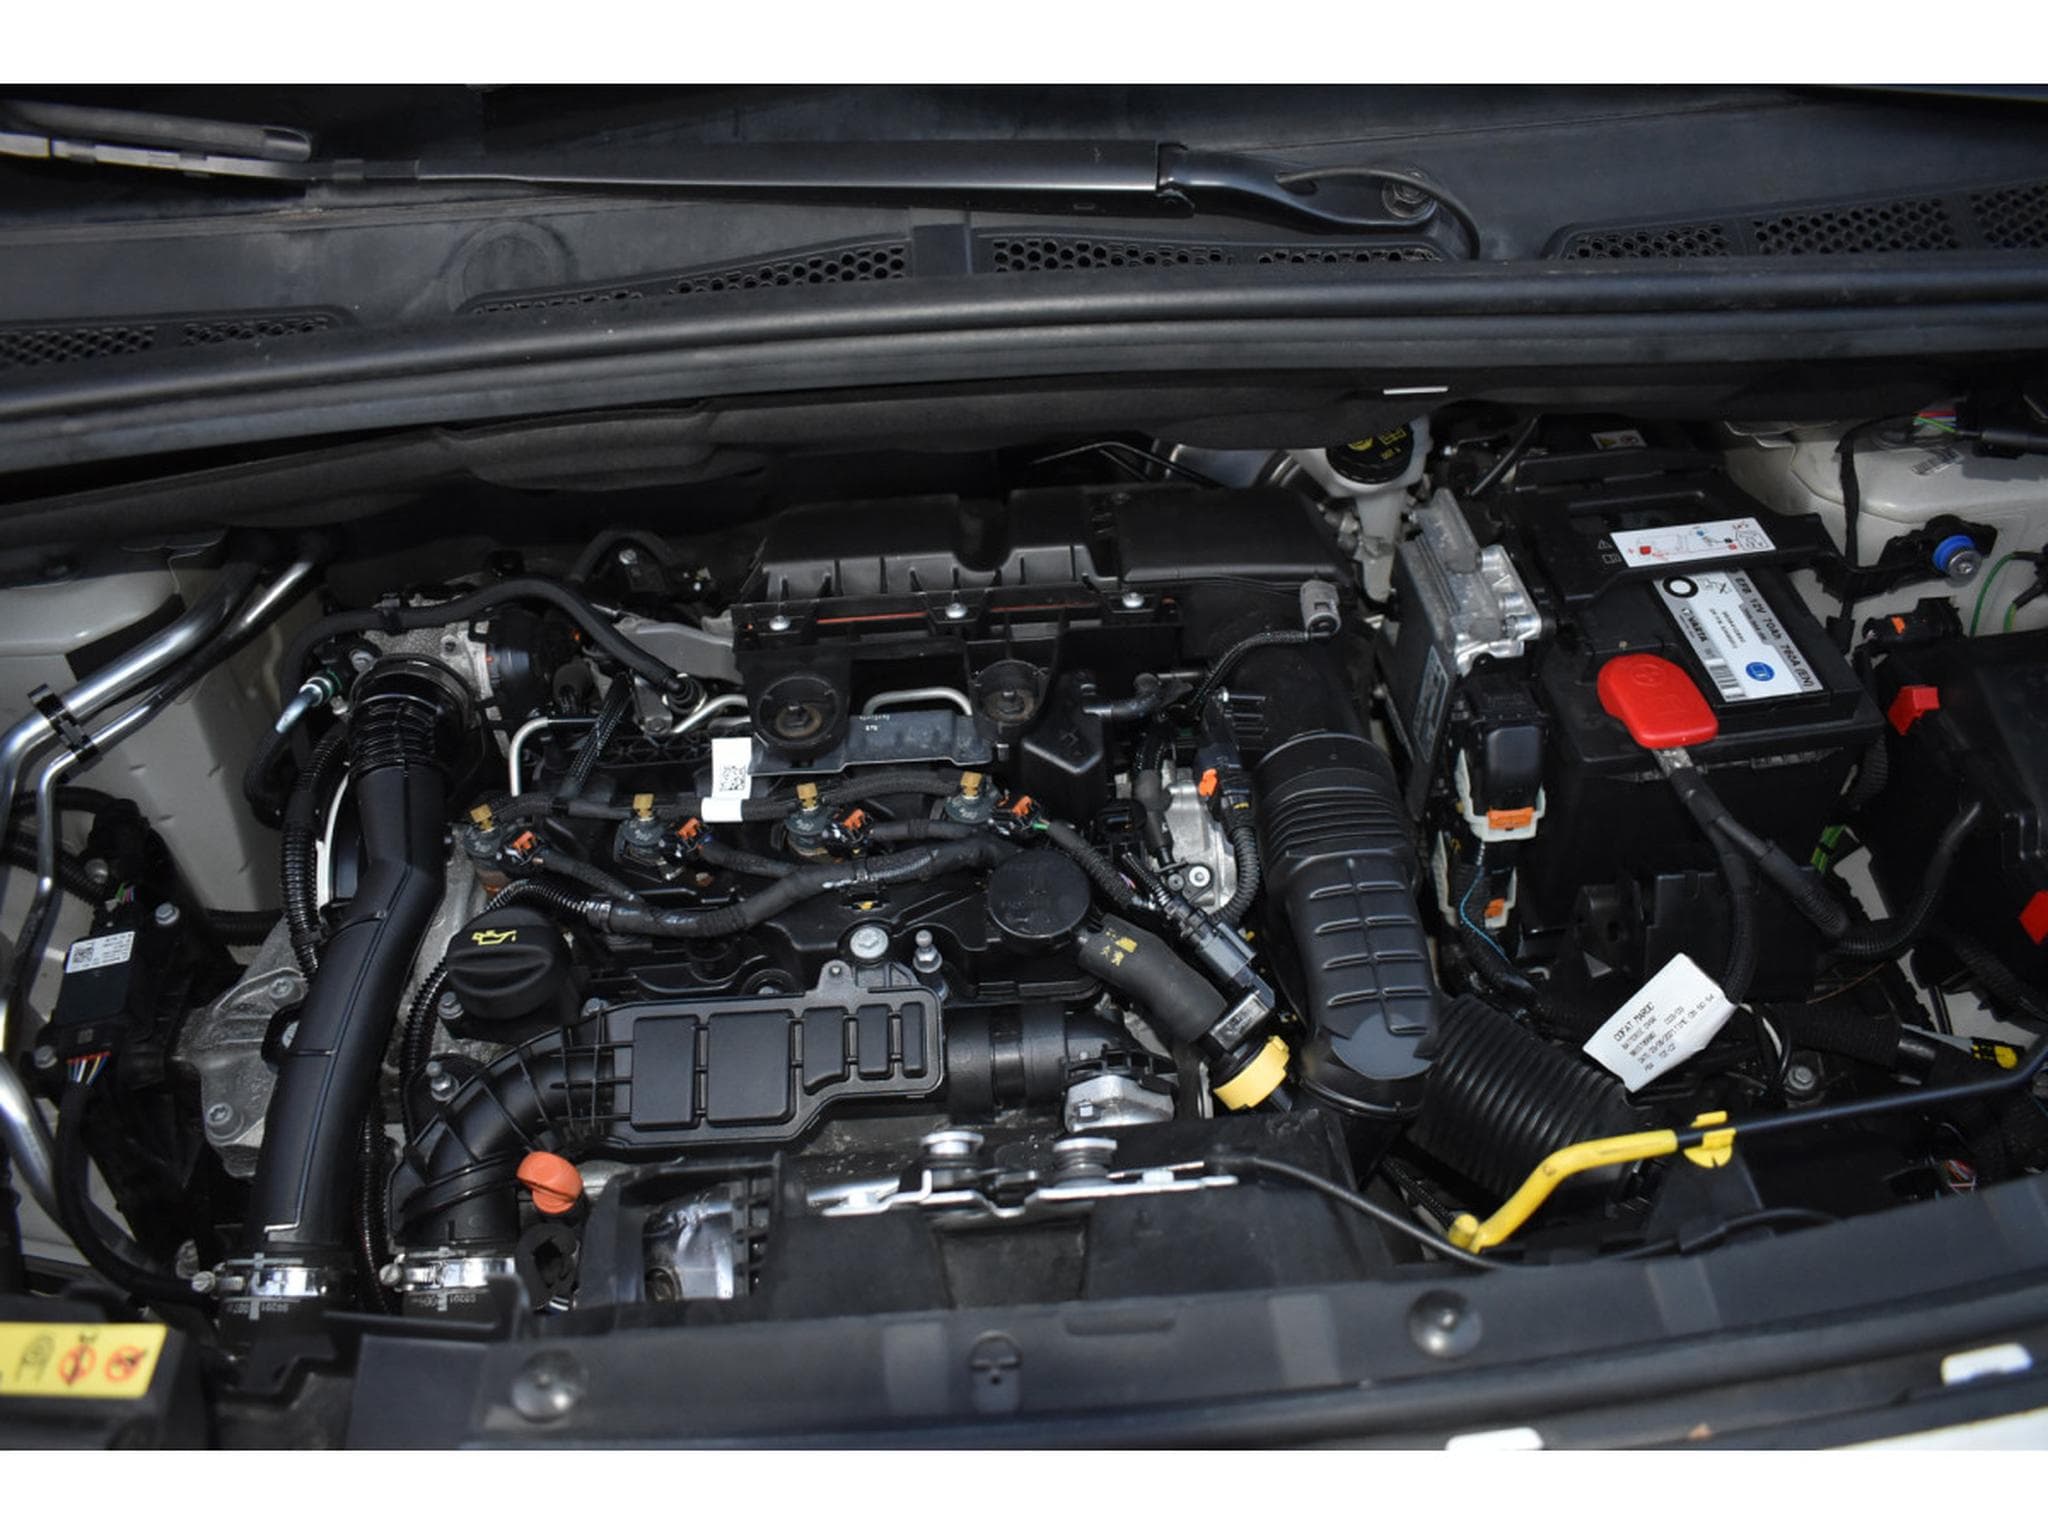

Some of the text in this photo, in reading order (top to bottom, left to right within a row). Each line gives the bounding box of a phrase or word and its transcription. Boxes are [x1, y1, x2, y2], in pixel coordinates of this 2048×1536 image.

[1688, 616, 1708, 642] VARTA
[1750, 598, 1767, 614] 12V
[1763, 618, 1782, 640] 70Ah
[1795, 668, 1815, 687] (EN)
